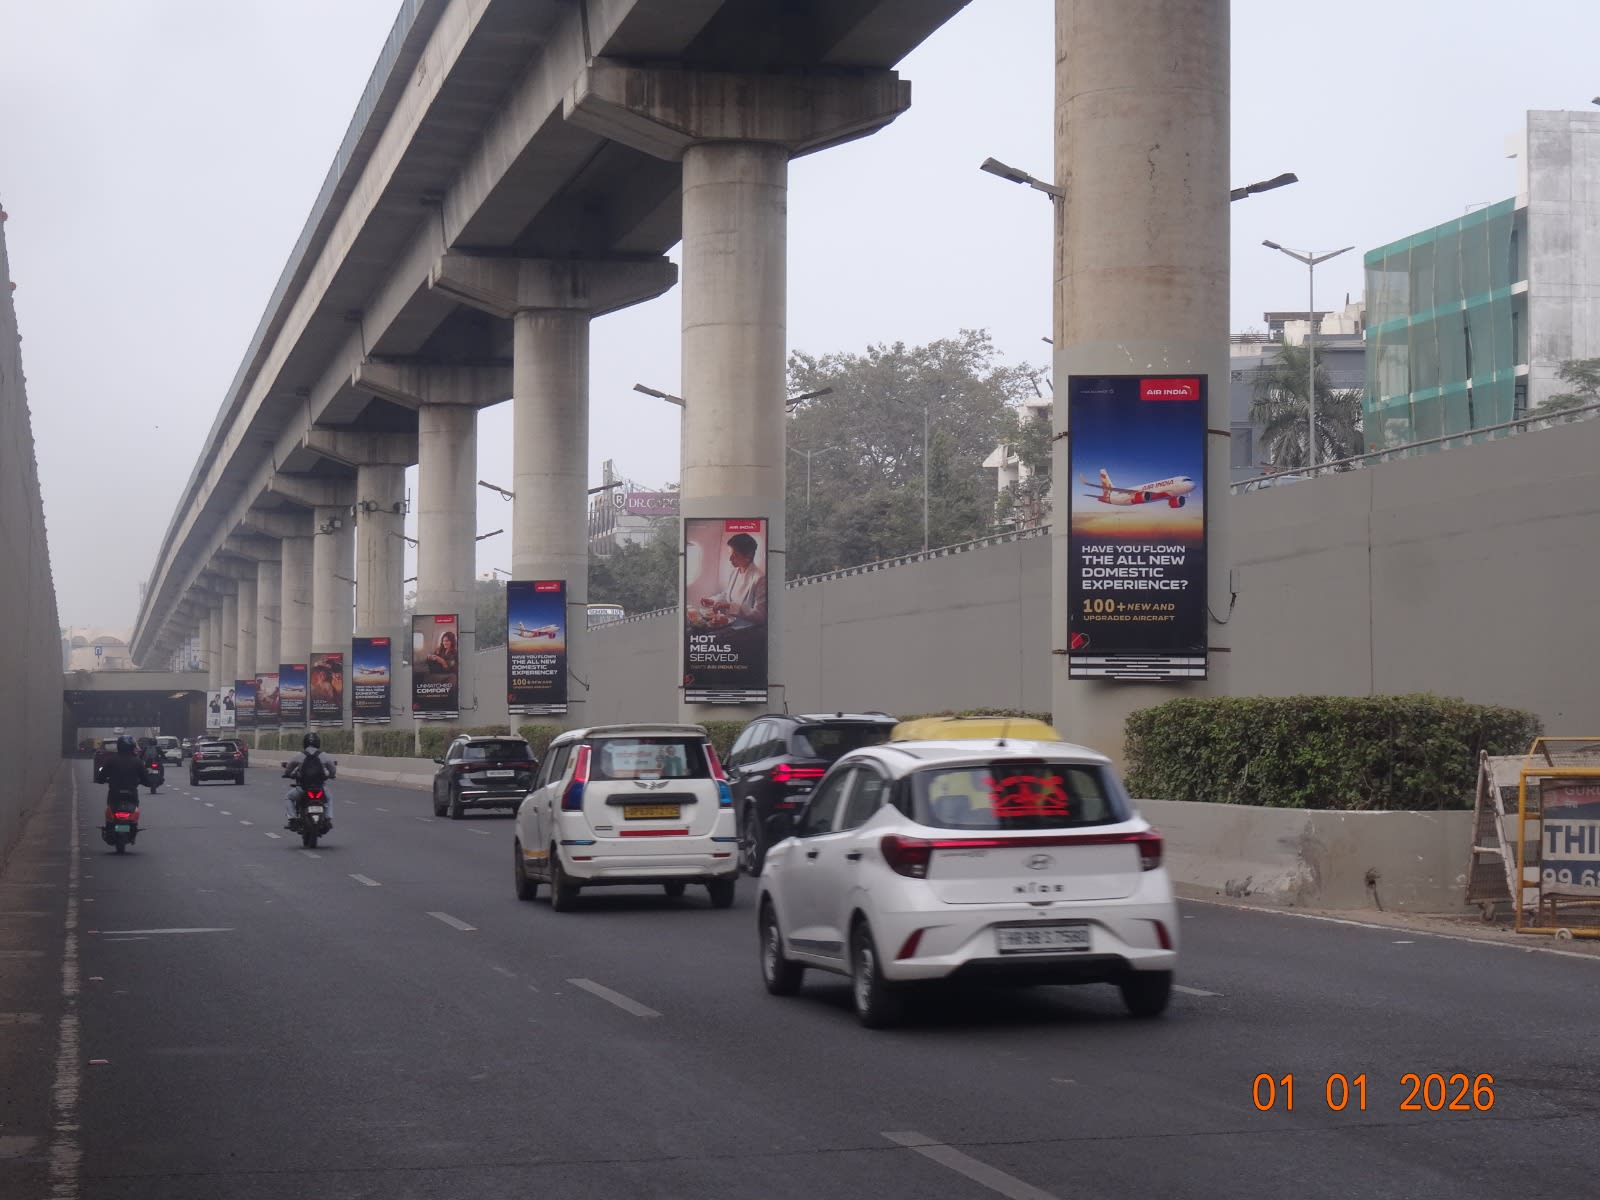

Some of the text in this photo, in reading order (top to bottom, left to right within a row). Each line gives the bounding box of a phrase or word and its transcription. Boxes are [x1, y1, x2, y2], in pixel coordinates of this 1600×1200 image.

[1081, 545, 1186, 553] HAVE YOU FLOWN
[1082, 555, 1185, 565] THE ALL NEW
[1082, 567, 1164, 578] DOMESTIC
[1082, 579, 1189, 590] EXPERIENCE?
[1127, 603, 1152, 611] NEW
[1152, 603, 1175, 611] AND
[690, 635, 716, 643] HOT
[690, 644, 732, 652] MEALS
[690, 653, 739, 662] SERVED!
